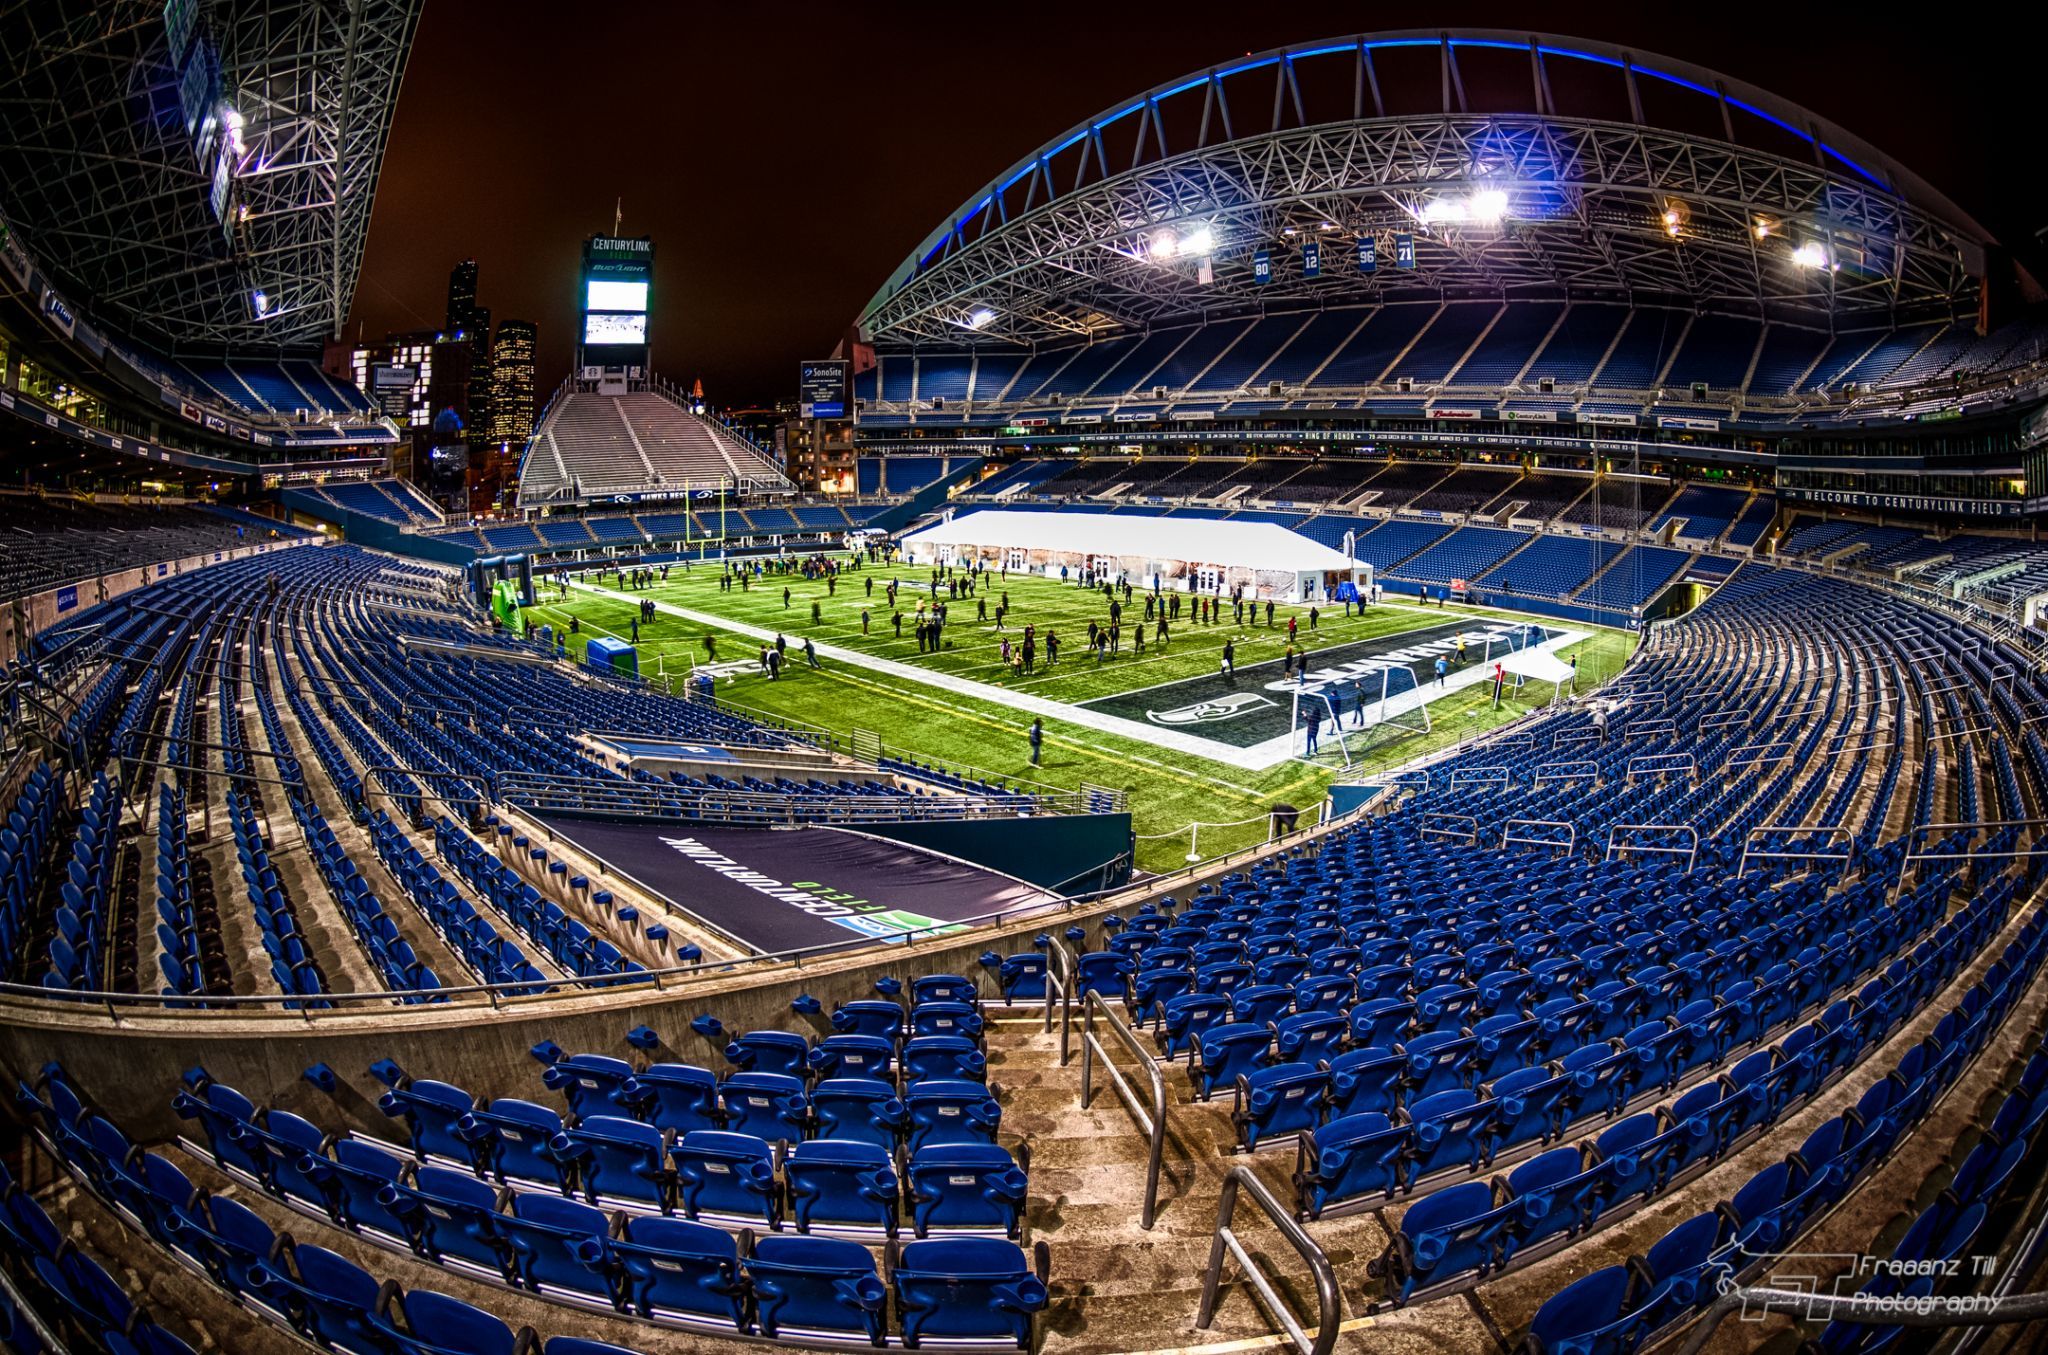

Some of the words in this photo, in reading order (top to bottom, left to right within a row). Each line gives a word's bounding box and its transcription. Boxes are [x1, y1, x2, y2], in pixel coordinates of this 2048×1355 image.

[593, 237, 650, 252] CENTURYLINK
[1359, 250, 1375, 263] 96
[1398, 247, 1412, 261] 71
[1305, 256, 1317, 269] 12
[1255, 263, 1269, 276] 80
[813, 367, 842, 377] SonoSite
[1305, 432, 1320, 440] RING
[1322, 432, 1330, 440] OF
[1333, 432, 1355, 440] HONOR
[640, 491, 668, 501] HAWKS
[669, 491, 688, 500] NEST
[1804, 491, 1858, 504] WELCOME
[1865, 495, 1878, 506] TO
[1884, 497, 1964, 513] CENTURYLINK
[1971, 502, 2003, 515] FIELD
[658, 836, 855, 916] CENTURYLINK
[791, 881, 887, 912] FIELD
